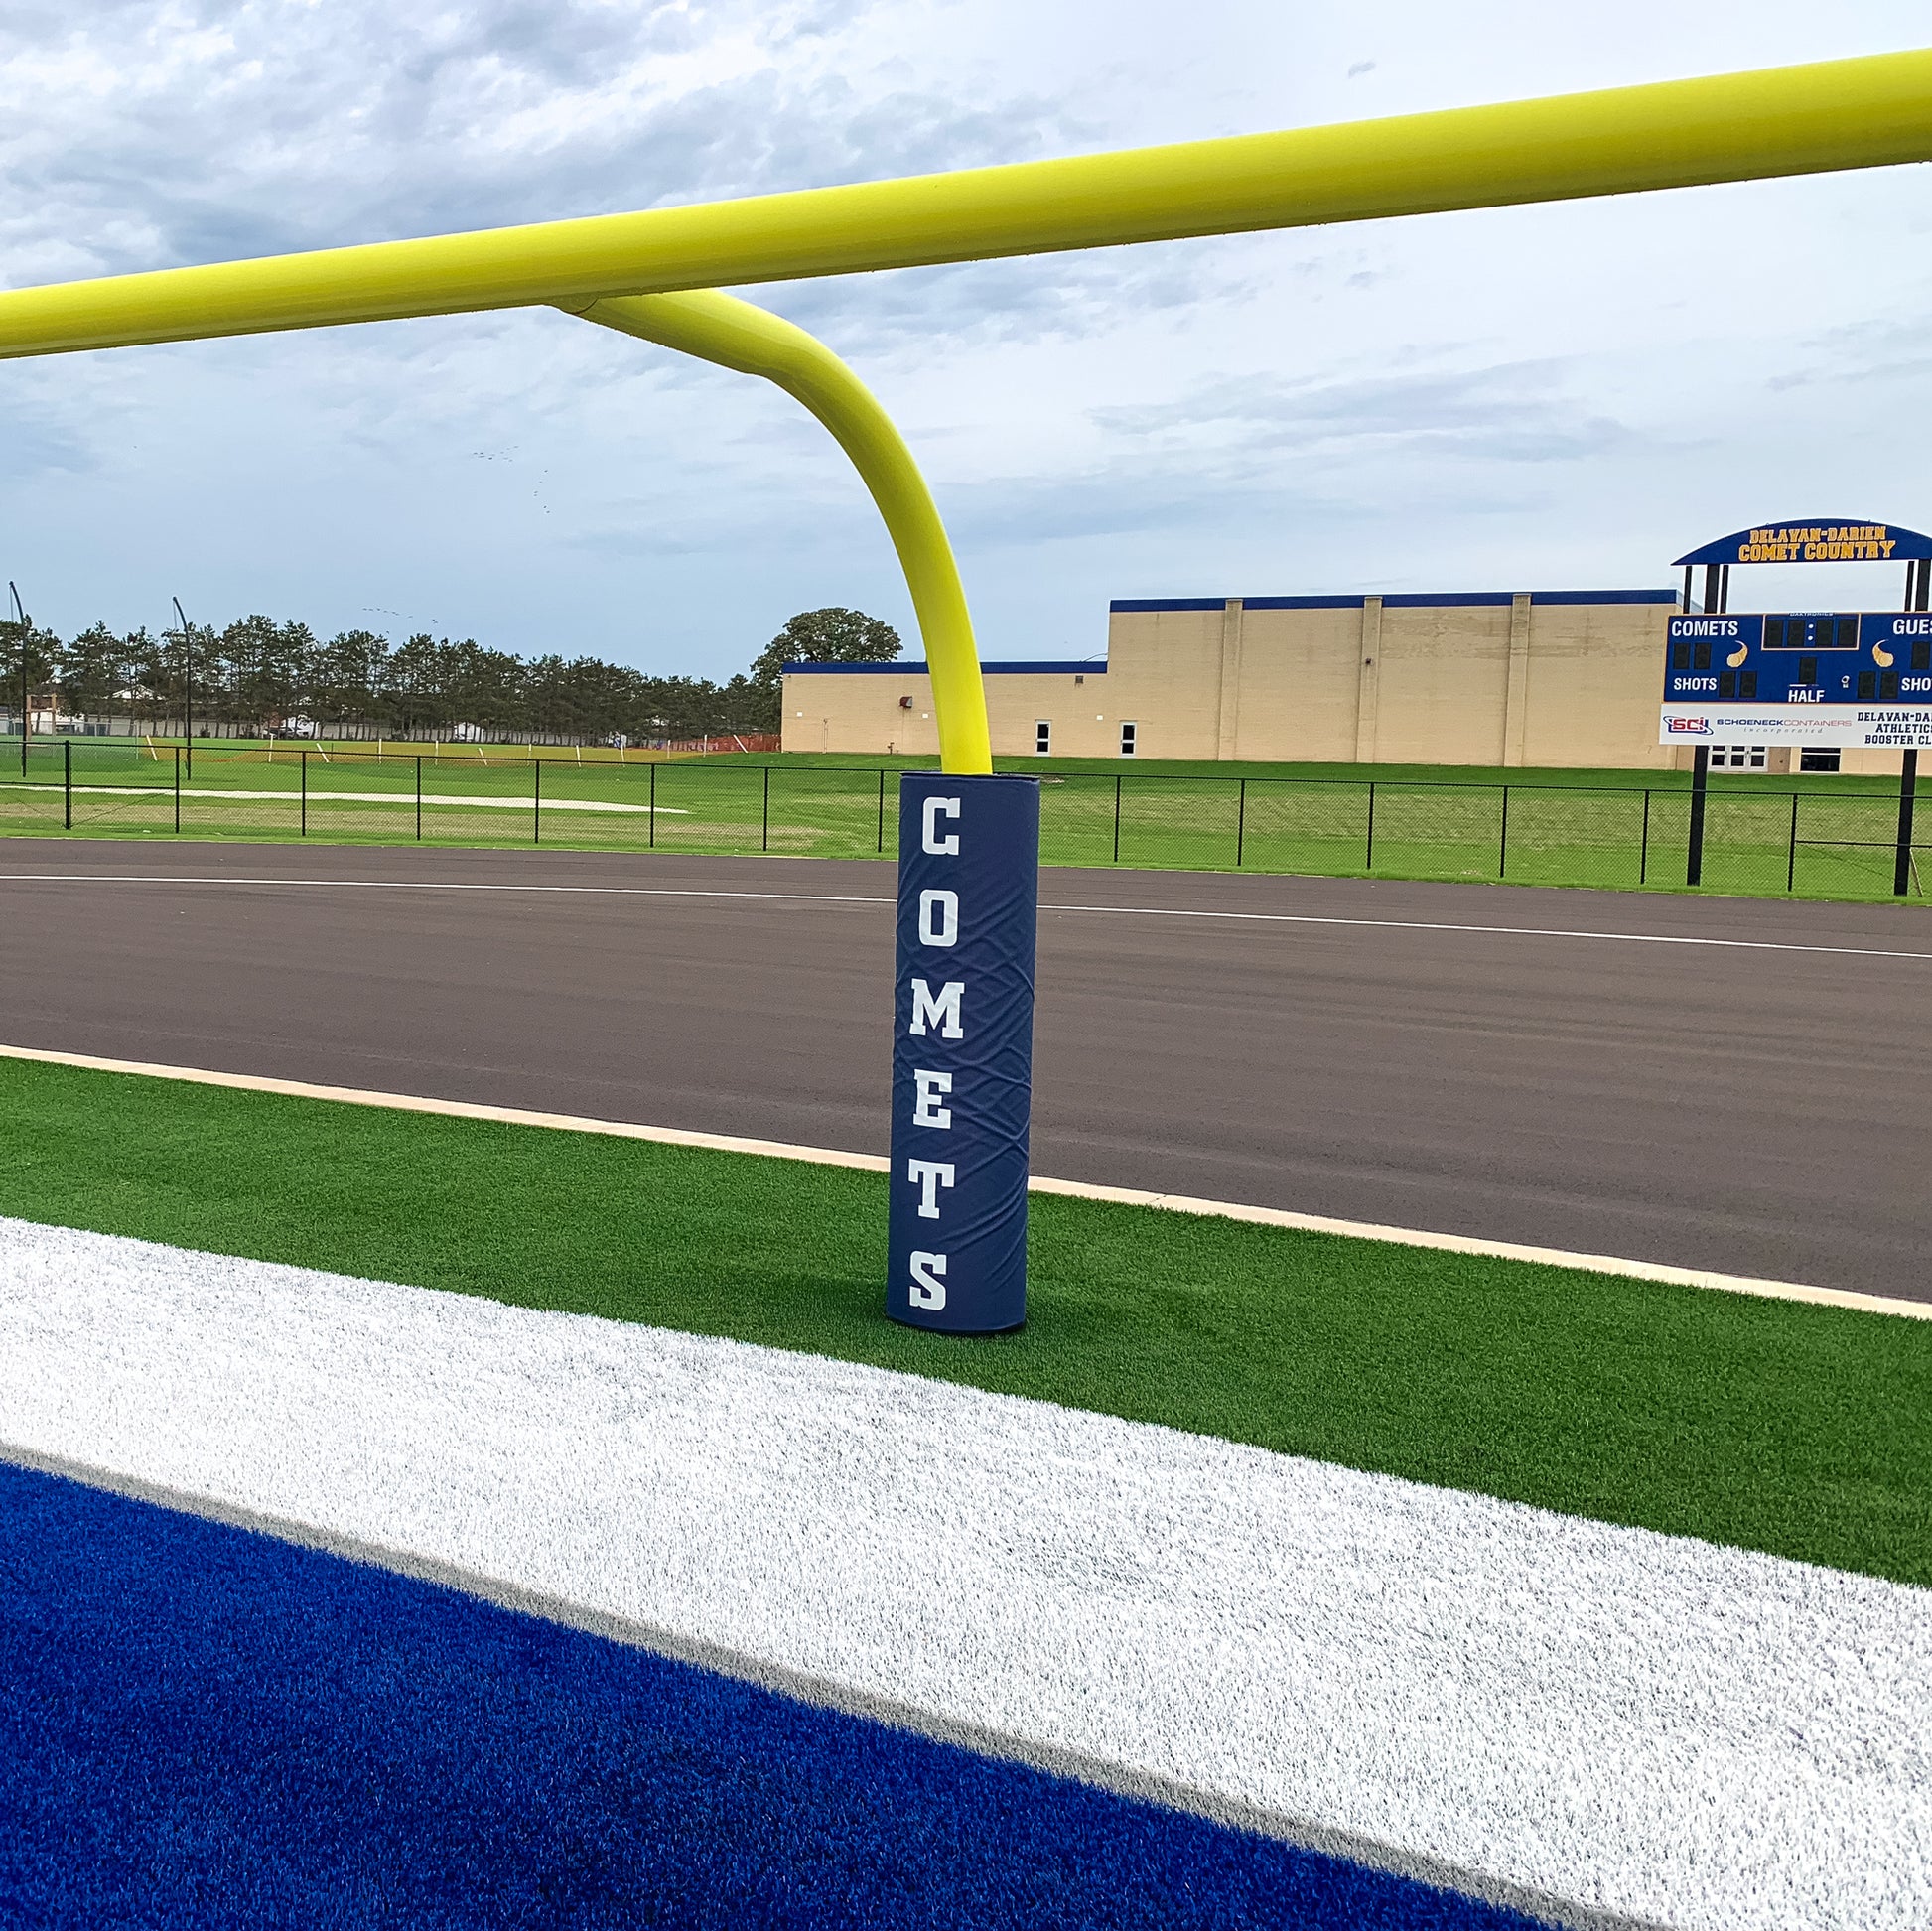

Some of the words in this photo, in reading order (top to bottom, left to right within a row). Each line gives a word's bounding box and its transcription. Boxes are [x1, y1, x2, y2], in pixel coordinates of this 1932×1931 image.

[1750, 526, 1886, 544] DELAVAN-DARIEN
[1738, 543, 1800, 562] COMET
[1804, 540, 1896, 560] COUNTRY
[1671, 621, 1739, 637] COMETS
[1892, 619, 1932, 635] GUE
[1673, 677, 1718, 691] SHOTS
[1900, 677, 1932, 691] SHO
[1788, 689, 1825, 703] HALF
[1875, 723, 1932, 734] ATHLETIC
[1864, 734, 1914, 745] BOOSTER
[908, 795, 965, 1312] COMETS
